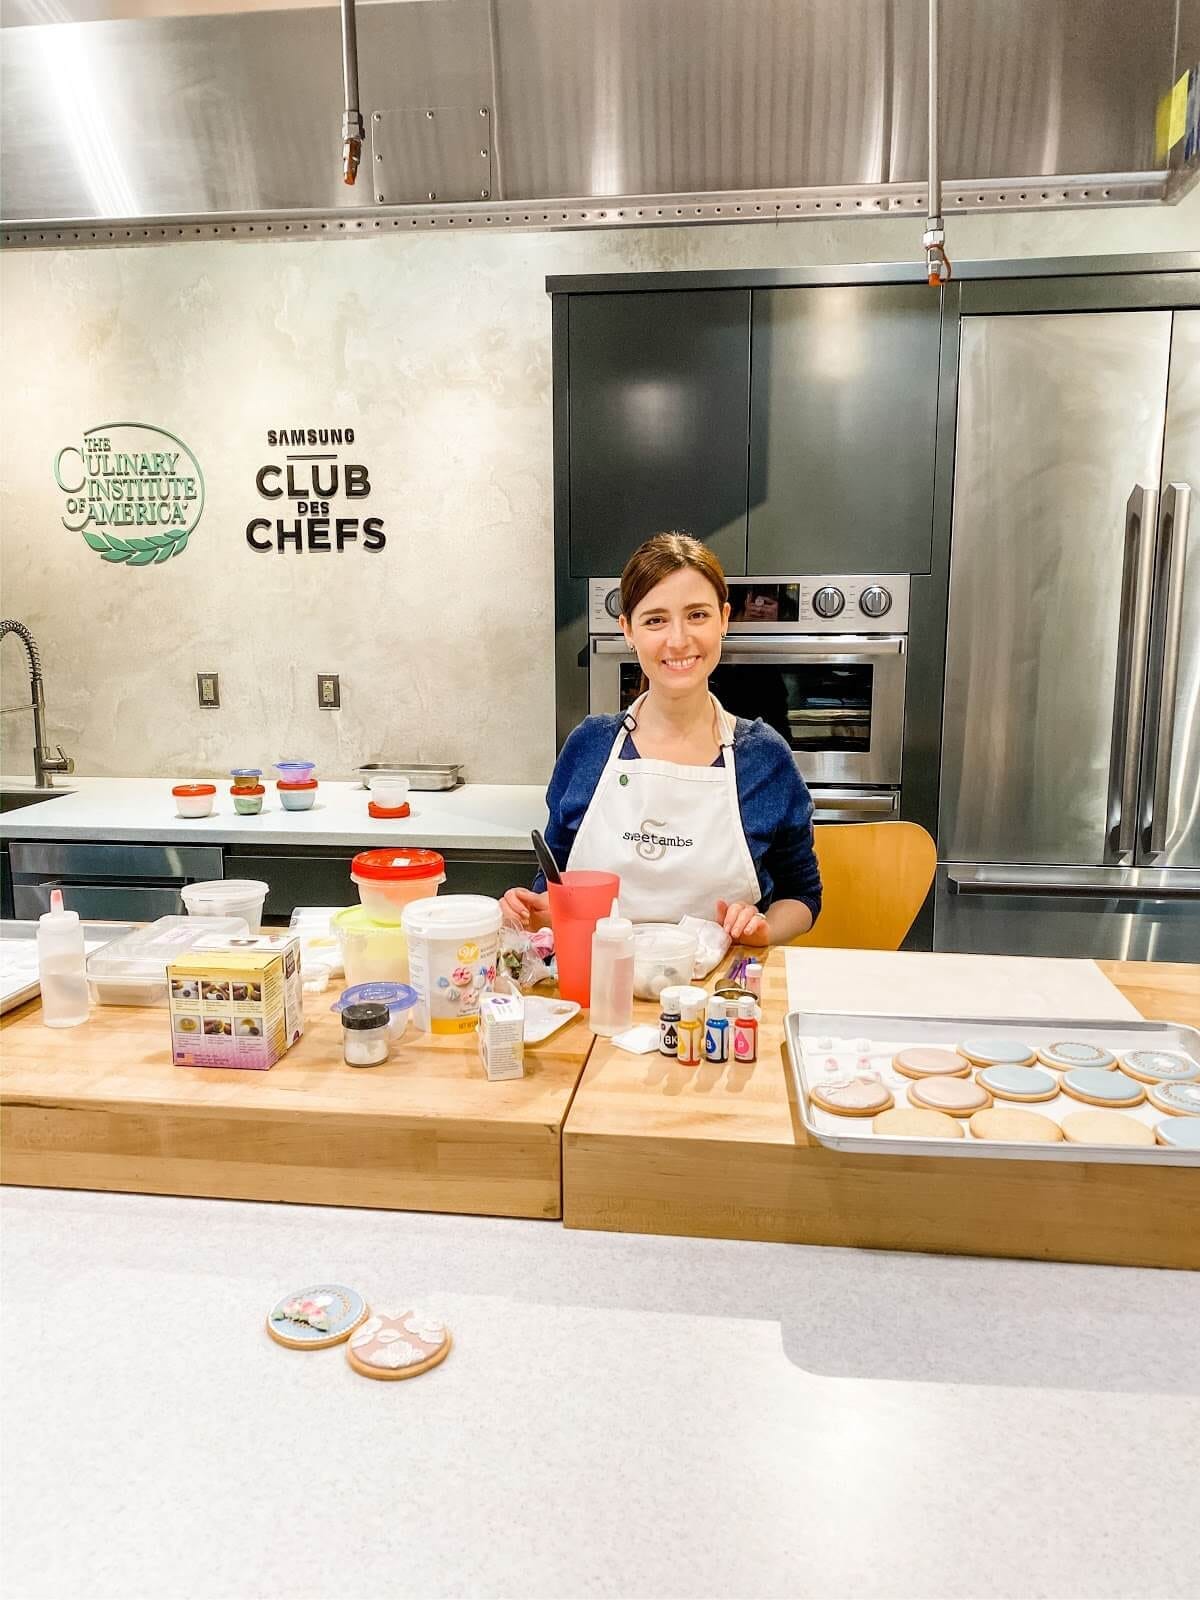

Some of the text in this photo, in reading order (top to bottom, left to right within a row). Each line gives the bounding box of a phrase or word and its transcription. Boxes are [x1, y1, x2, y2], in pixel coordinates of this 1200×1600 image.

[84, 438, 111, 452] THE
[267, 428, 355, 446] SAMSUNG
[54, 446, 179, 493] CULINARY
[87, 478, 197, 501] INSTITUTE
[256, 465, 371, 499] CLUB
[66, 498, 188, 526] OF AMERICA
[297, 501, 329, 516] DES
[246, 518, 386, 554] CHEFS
[664, 1035, 678, 1045] BK
